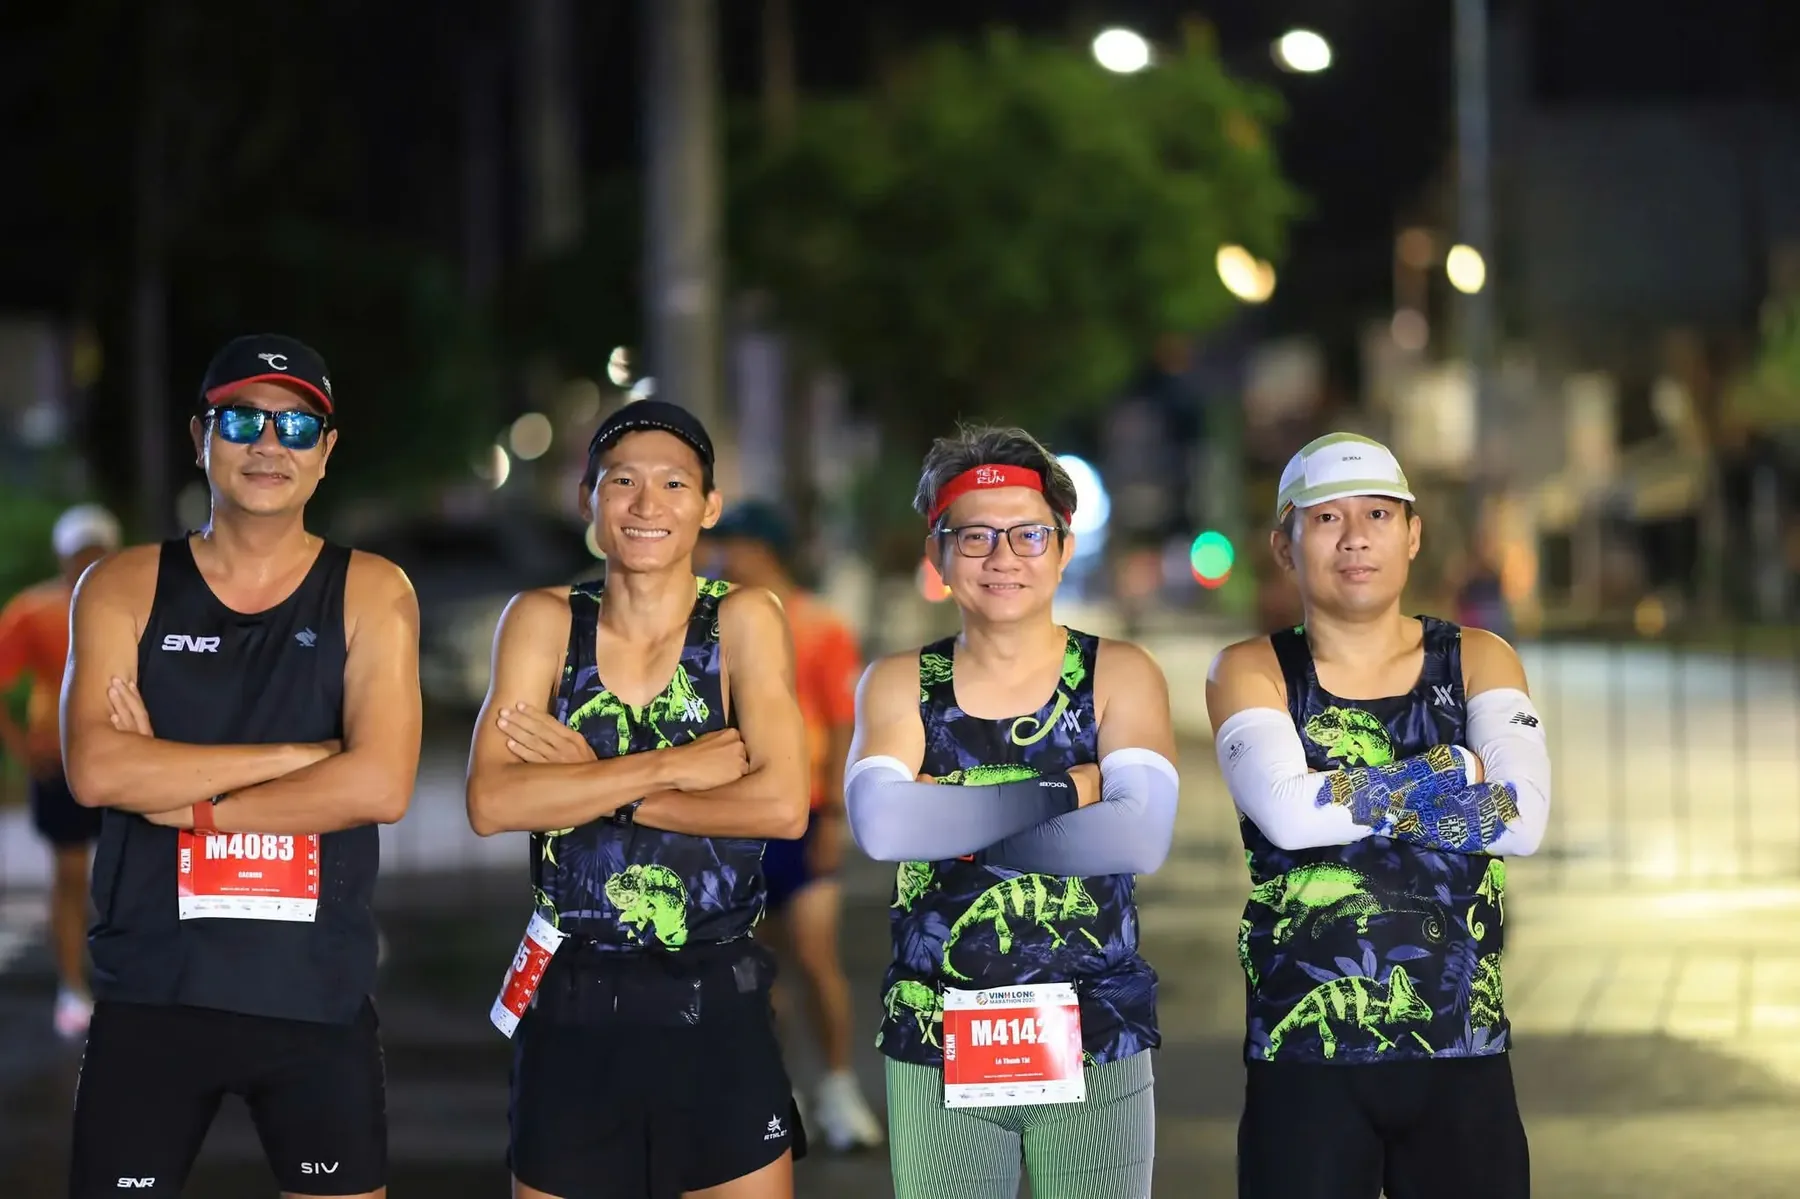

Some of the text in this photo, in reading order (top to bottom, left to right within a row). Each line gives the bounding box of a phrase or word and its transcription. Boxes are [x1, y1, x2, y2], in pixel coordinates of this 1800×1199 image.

[161, 634, 221, 653] SNR
[1438, 818, 1451, 840] BUSH
[1448, 815, 1462, 845] FLAT
[205, 833, 295, 861] M4083
[989, 991, 1036, 999] VINH LONG
[970, 1017, 1050, 1047] M4142
[946, 1034, 956, 1061] 42KM
[300, 1162, 339, 1174] SIV
[117, 1177, 155, 1188] SNR
